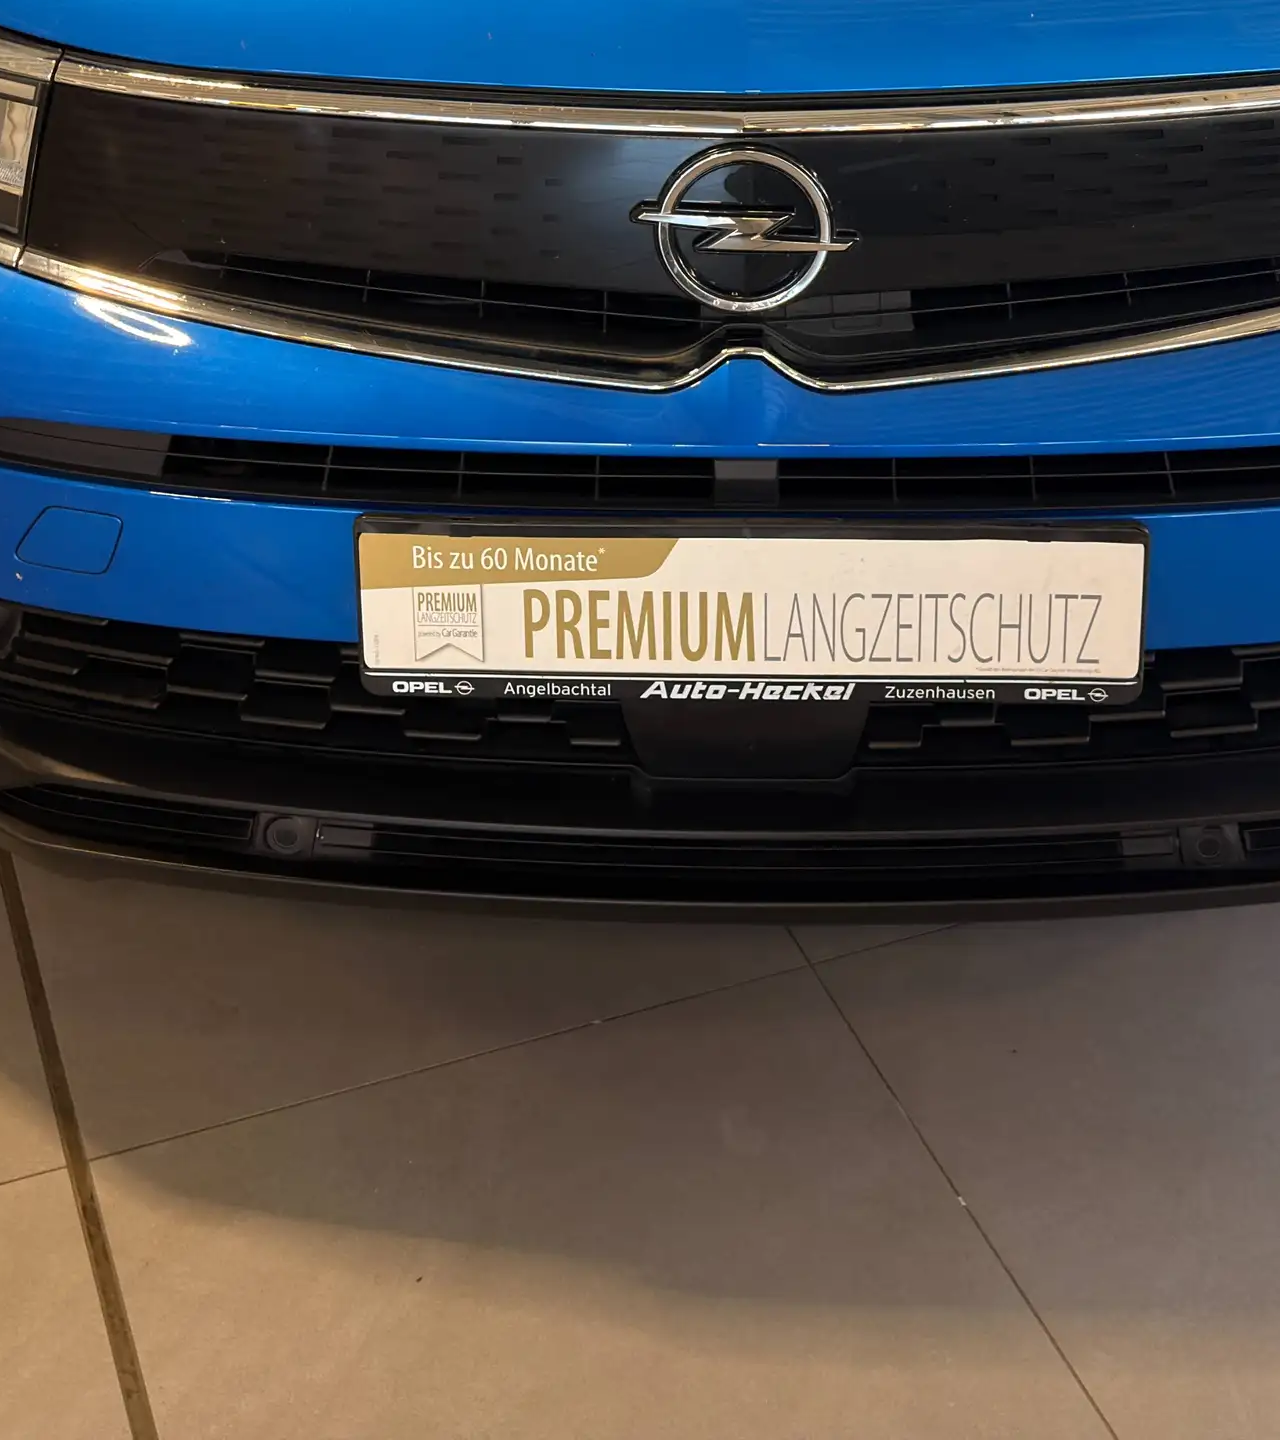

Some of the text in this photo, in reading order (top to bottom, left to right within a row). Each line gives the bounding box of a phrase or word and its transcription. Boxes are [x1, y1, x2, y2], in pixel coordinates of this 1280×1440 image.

[411, 545, 444, 570] Bis
[449, 551, 474, 570] zu
[480, 547, 508, 570] 60
[417, 591, 478, 613] PREMIUM
[416, 611, 478, 624] LANGZEITSCHUTZ
[392, 680, 1086, 702] OPEL Angelbachtal Auto-Heckel Zuzenhausen OPEL
